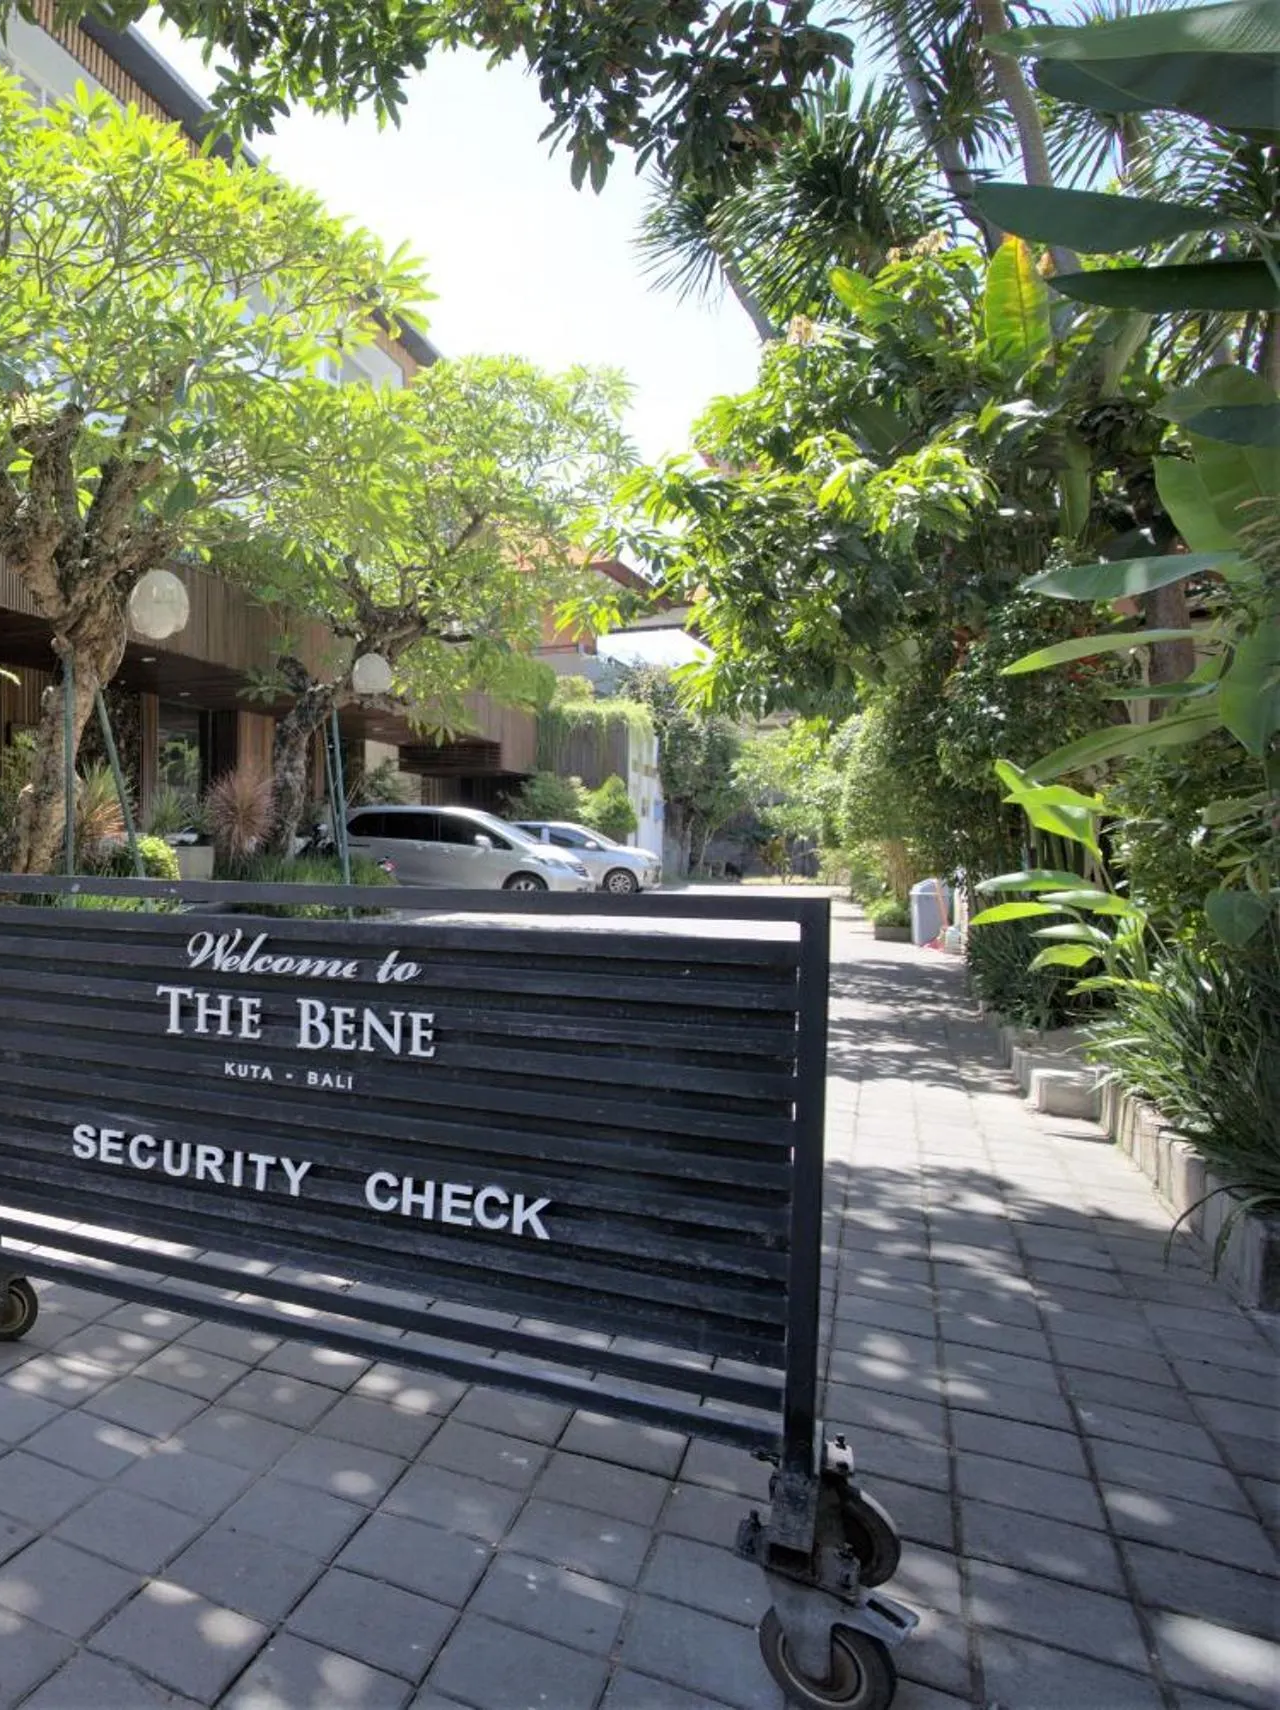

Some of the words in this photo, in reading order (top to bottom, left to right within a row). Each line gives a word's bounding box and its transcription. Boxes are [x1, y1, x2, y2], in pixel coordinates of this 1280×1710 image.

[187, 928, 357, 979] Welcome
[376, 950, 422, 983] to
[156, 985, 262, 1040] THE
[297, 998, 436, 1057] BENE
[224, 1062, 273, 1081] KUTA
[307, 1071, 353, 1090] BALI
[72, 1123, 312, 1197] SECURITY
[364, 1171, 551, 1239] CHECK
